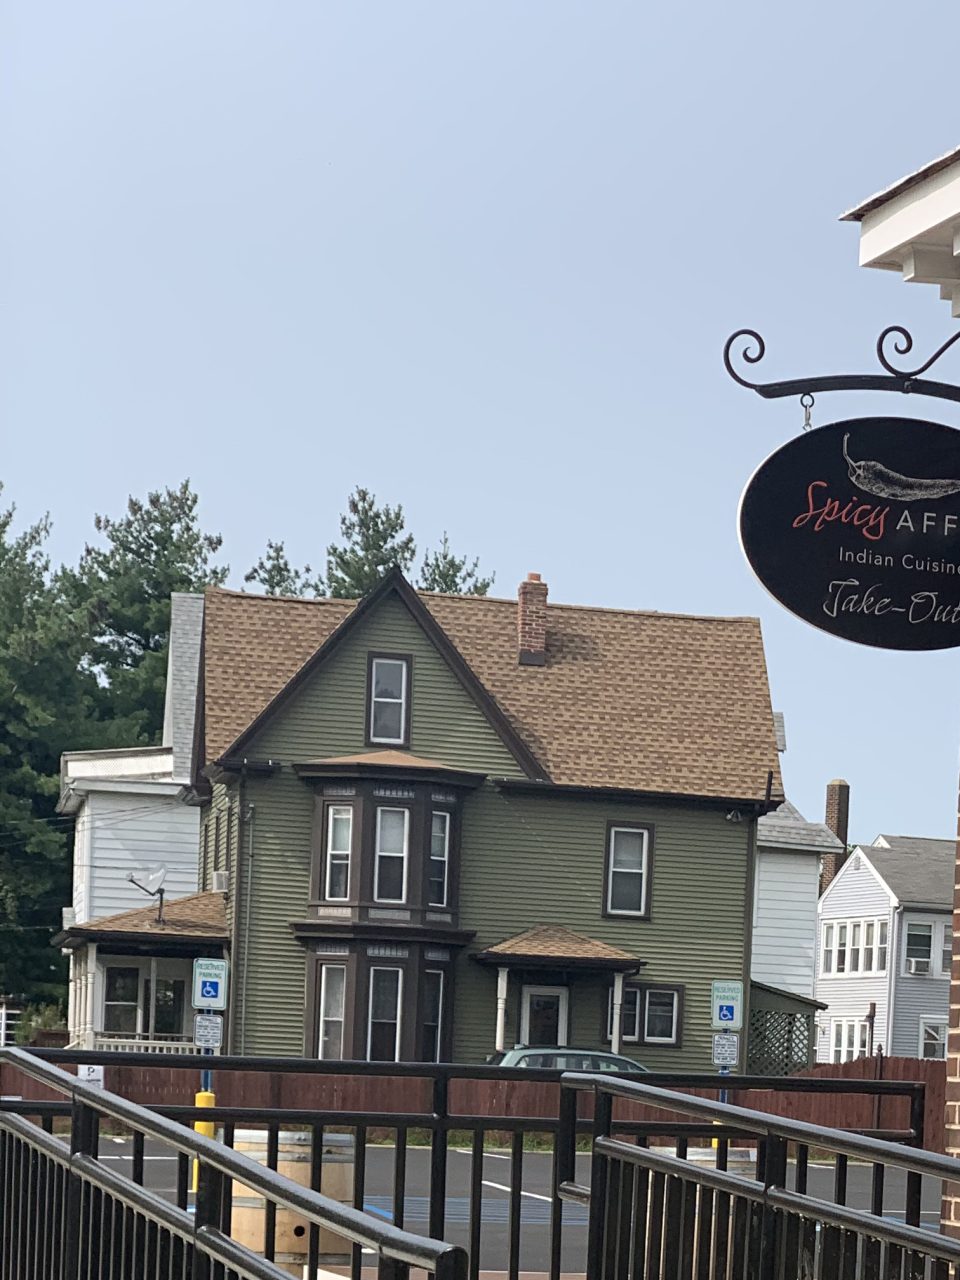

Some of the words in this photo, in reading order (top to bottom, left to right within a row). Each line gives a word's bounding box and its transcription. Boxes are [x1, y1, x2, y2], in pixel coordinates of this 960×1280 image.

[792, 481, 890, 540] Spicy
[839, 546, 894, 567] Indian
[714, 985, 741, 994] RESERVED
[715, 994, 739, 1002] PARKING
